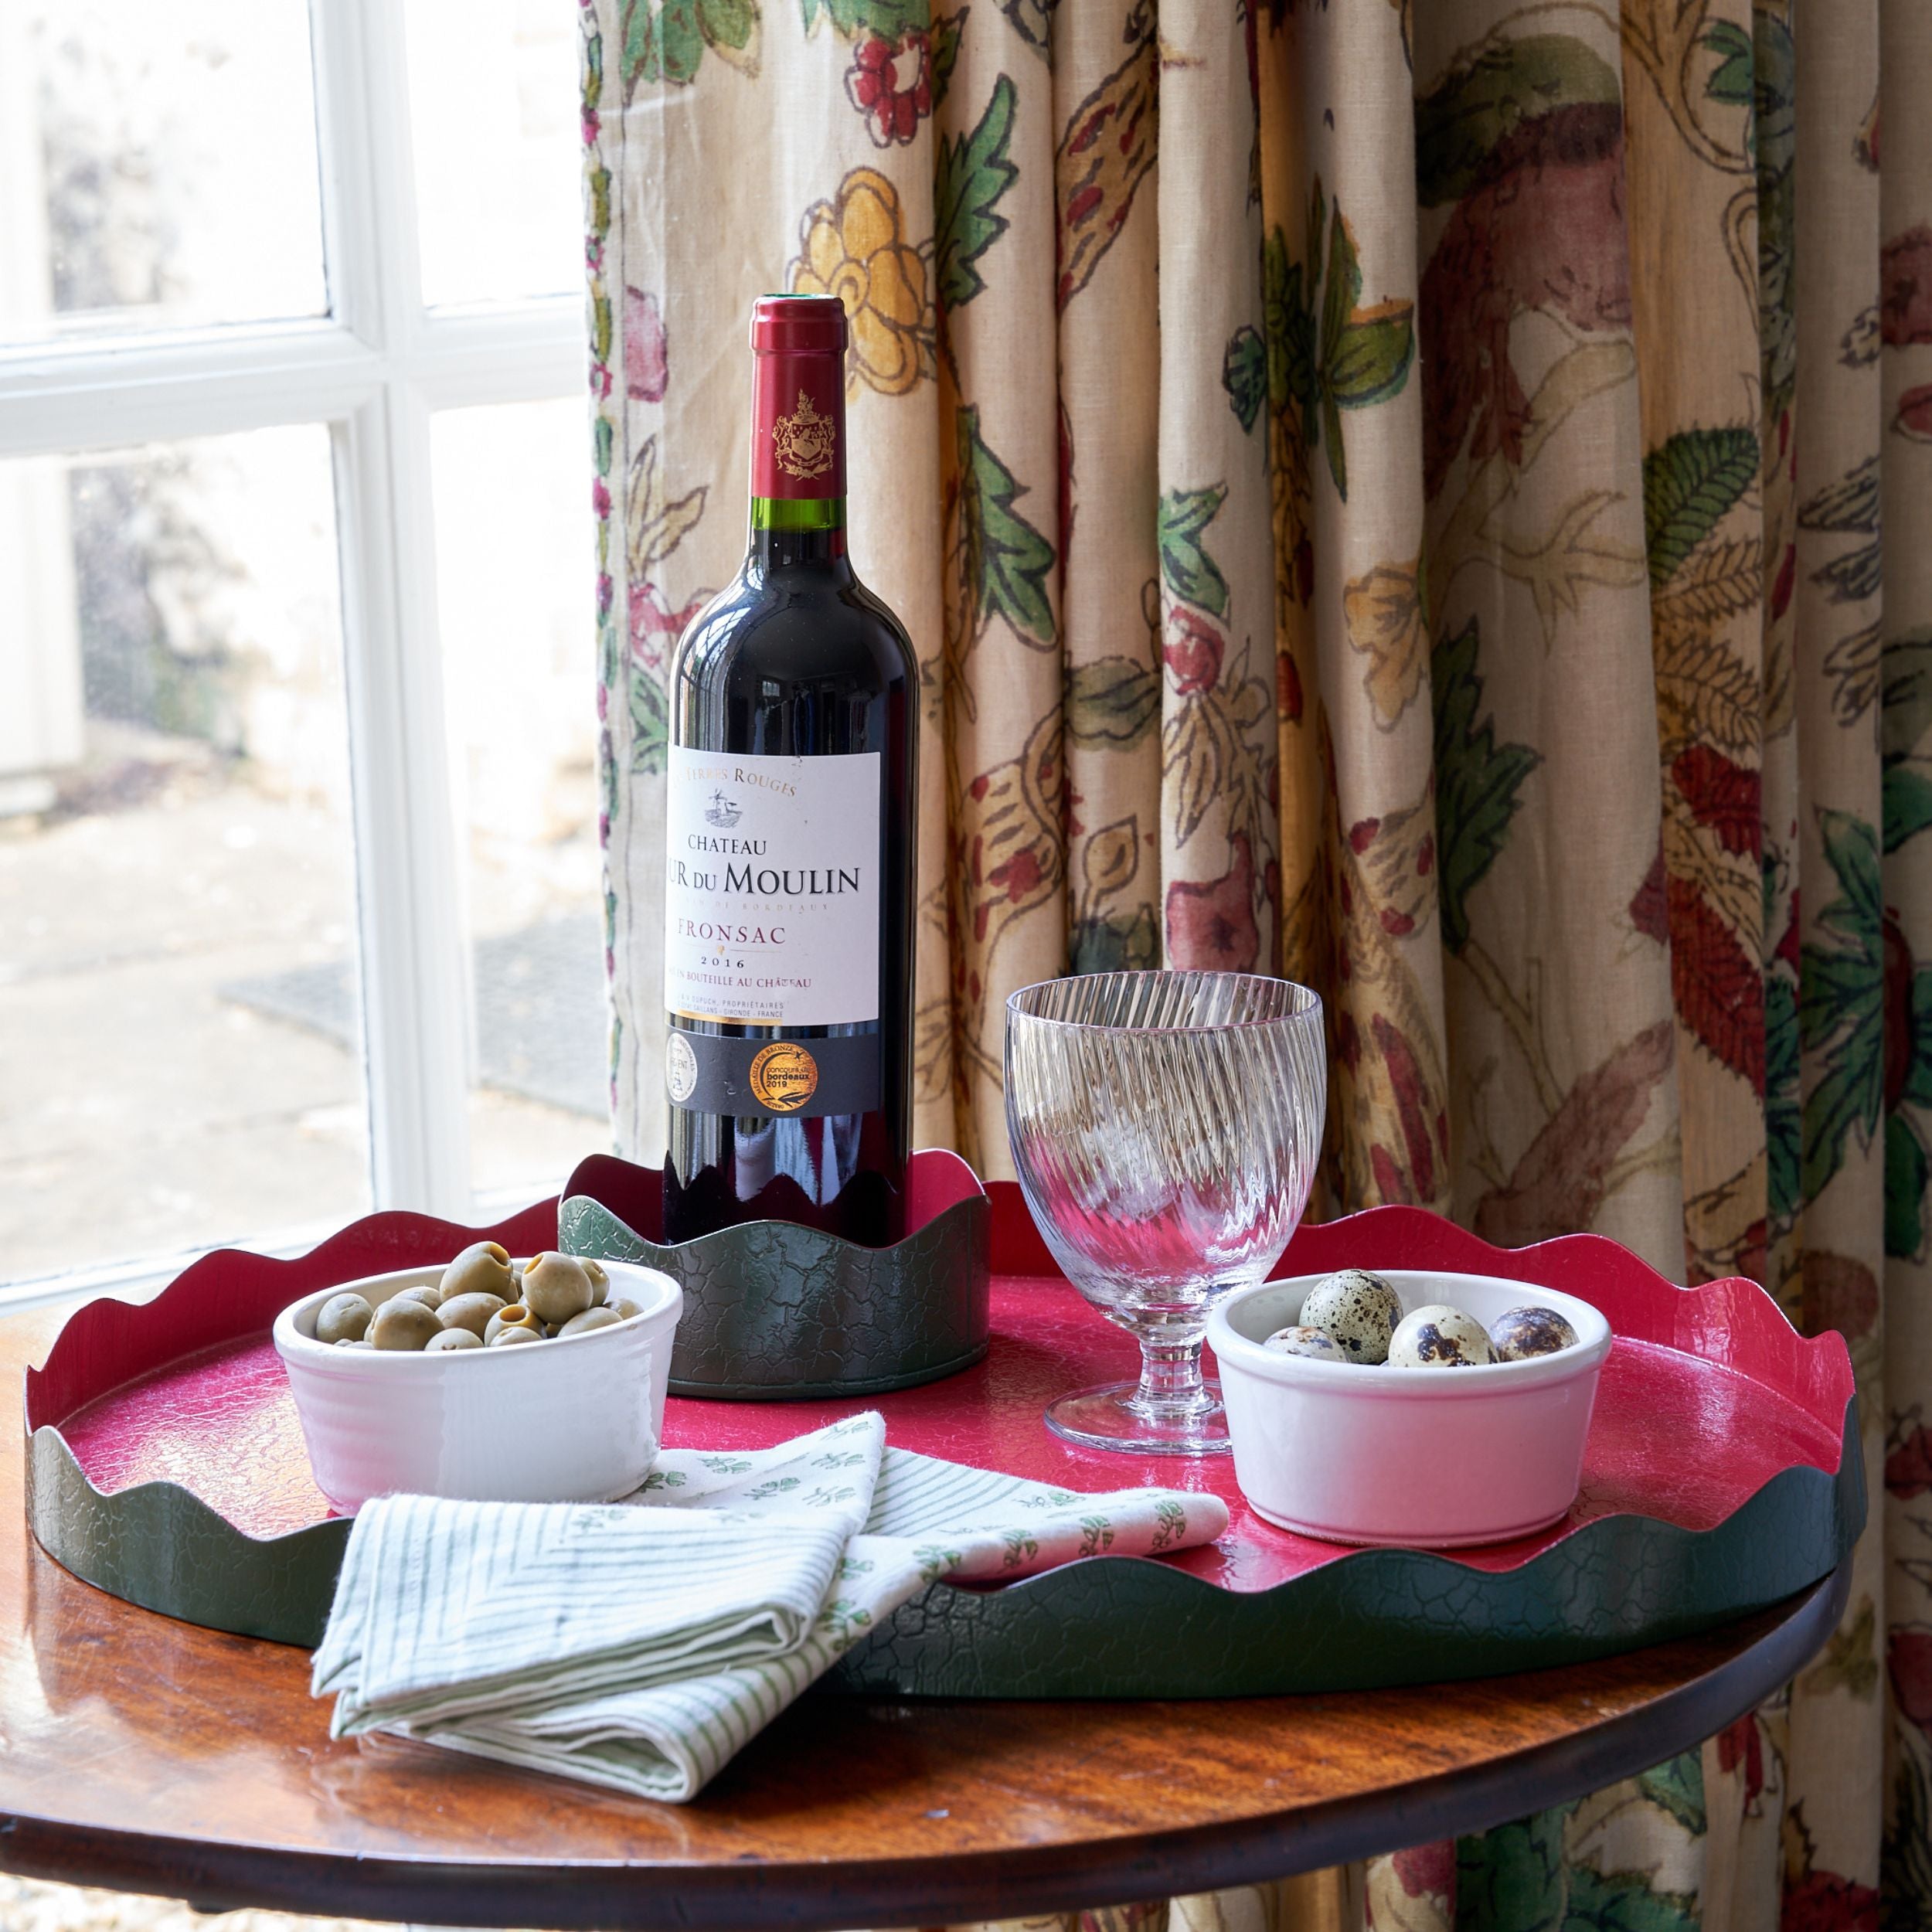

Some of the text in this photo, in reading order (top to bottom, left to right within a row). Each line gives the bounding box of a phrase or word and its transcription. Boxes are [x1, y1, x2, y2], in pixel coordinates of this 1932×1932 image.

[734, 767, 798, 798] ROUGES
[688, 834, 767, 855] CHATEAU
[693, 872, 719, 891] DU
[723, 862, 861, 895] MOULIN
[742, 902, 828, 911] BORDEAUX
[678, 917, 786, 944] FRONSAC
[701, 956, 745, 969] 2016
[686, 971, 734, 987] BOUTEILLE
[736, 978, 753, 988] AU
[723, 1008, 751, 1017] GIRONDE
[757, 1009, 784, 1019] FRANCE
